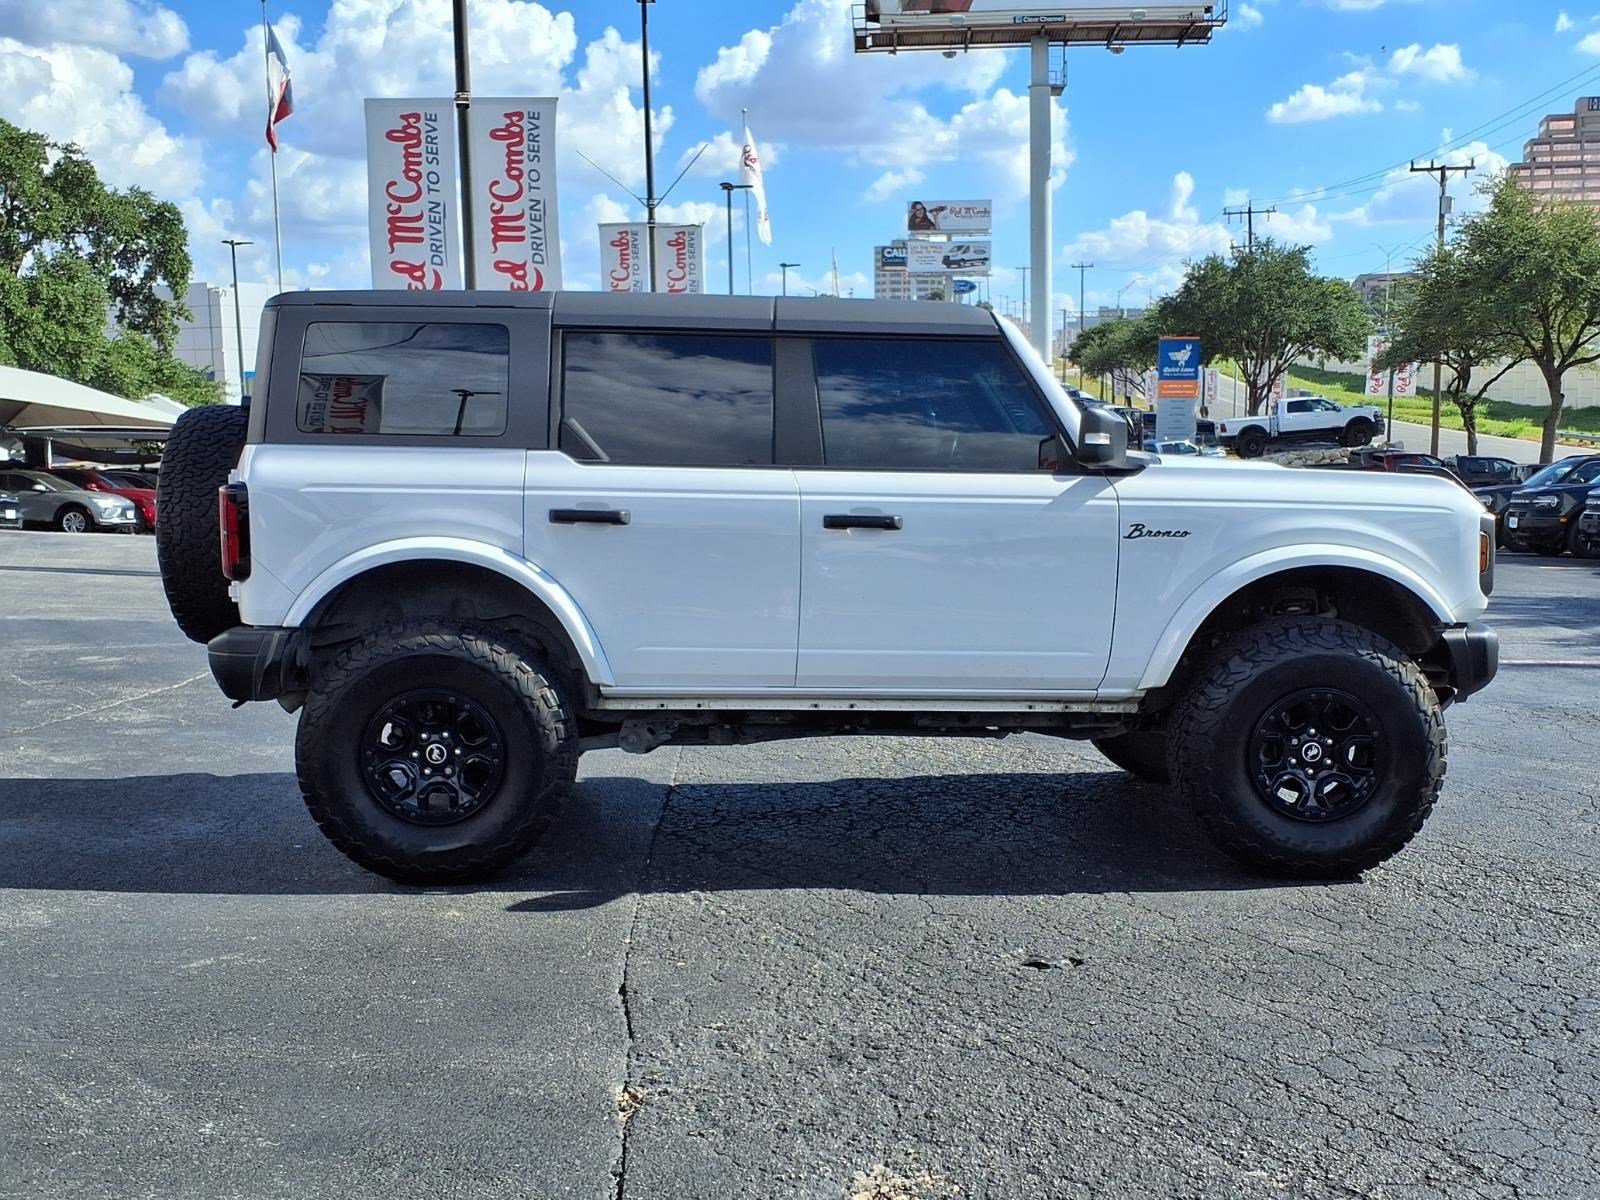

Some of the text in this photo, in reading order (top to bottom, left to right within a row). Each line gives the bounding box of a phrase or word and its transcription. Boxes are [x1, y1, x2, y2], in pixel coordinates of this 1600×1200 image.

[385, 112, 425, 254] McCombs
[425, 112, 444, 266] DRIVEN TO SERVE
[489, 111, 526, 254] McCombs
[527, 111, 544, 264] DRIVEN TO SERVE
[631, 230, 640, 263] SERVE
[688, 230, 696, 260] SERVE
[632, 263, 640, 277] TO
[688, 264, 696, 276] TO
[1122, 523, 1192, 539] Bronco
